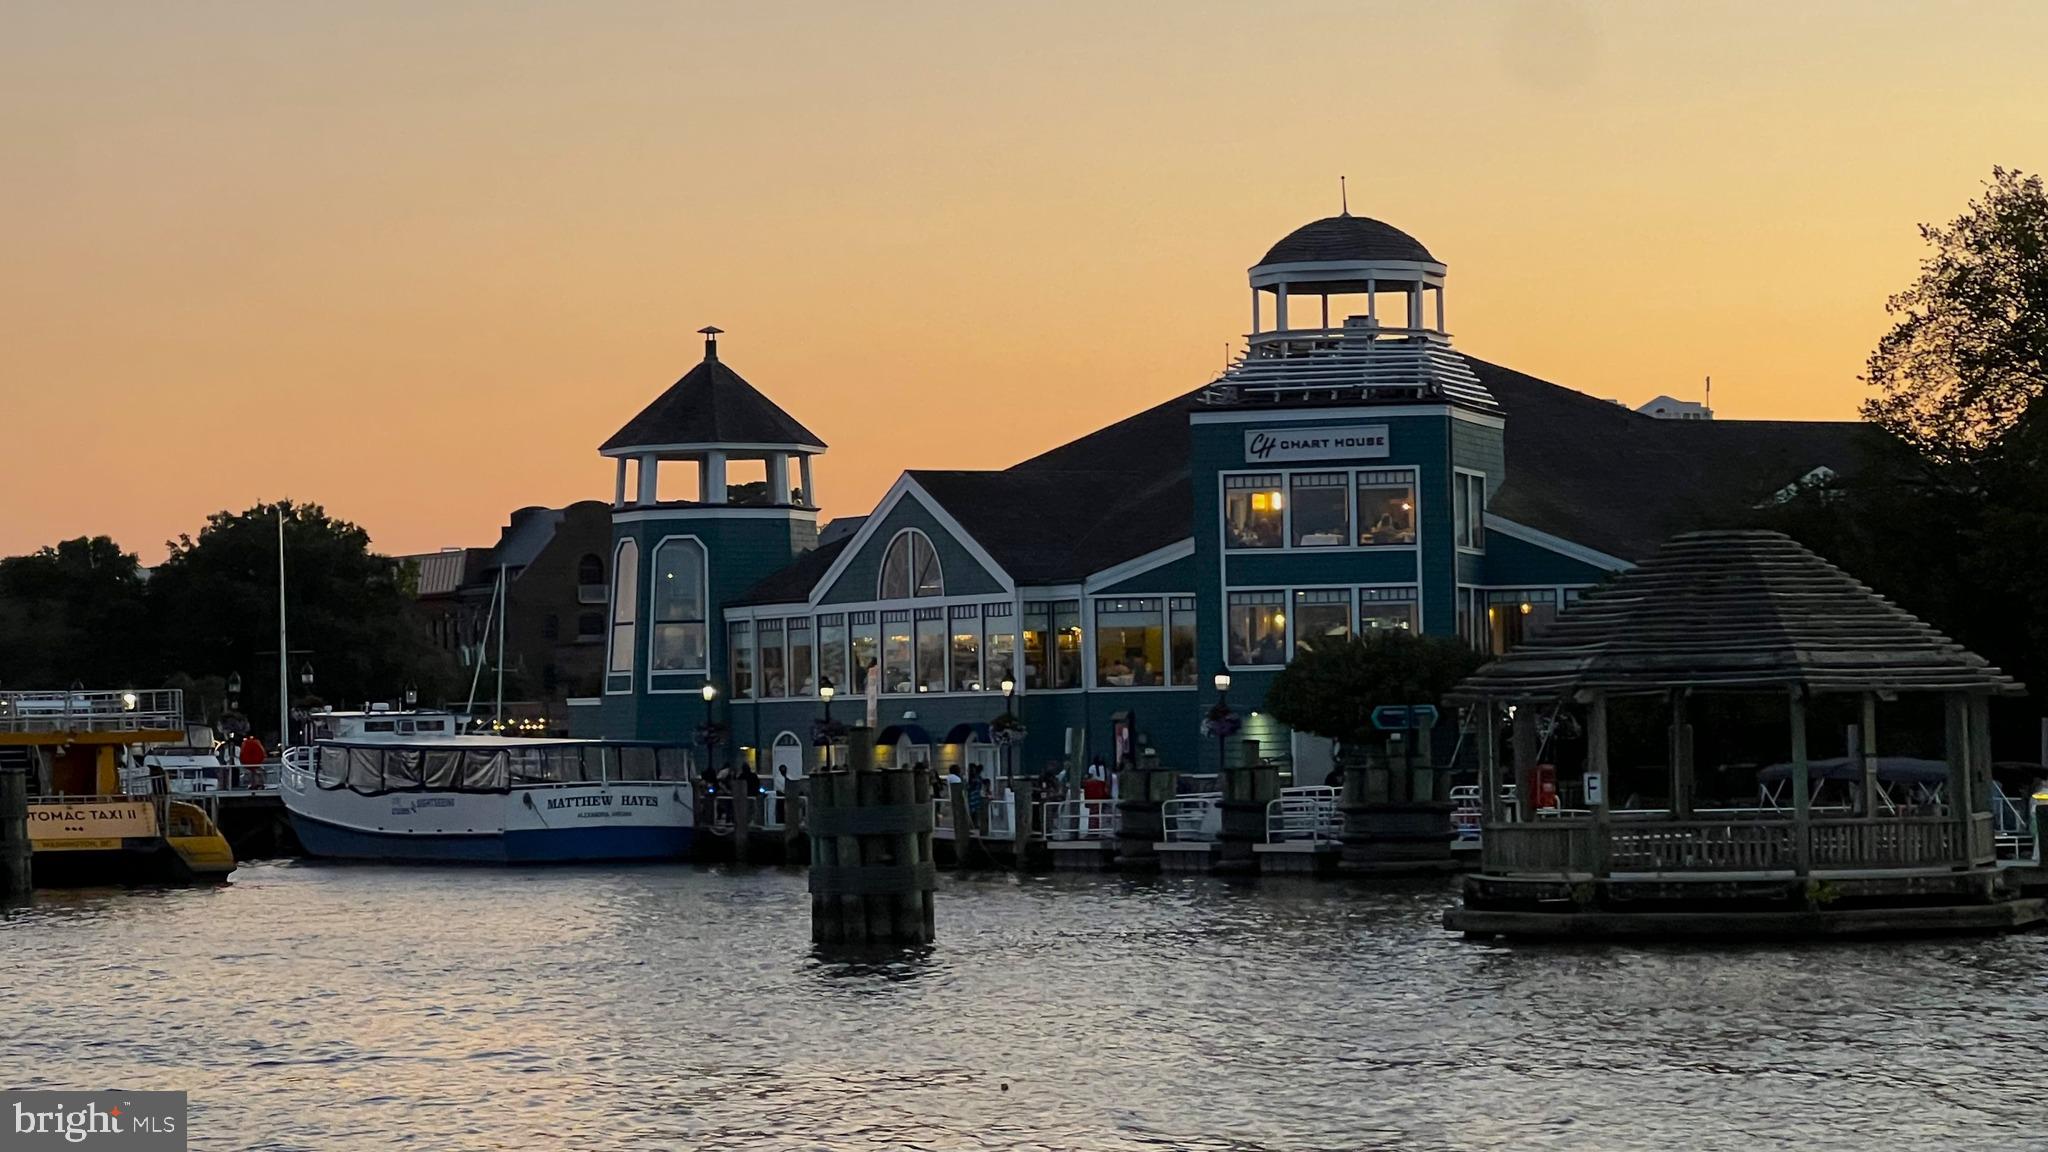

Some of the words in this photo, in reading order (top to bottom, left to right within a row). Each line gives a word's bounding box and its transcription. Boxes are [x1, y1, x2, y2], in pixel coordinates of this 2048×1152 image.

[1280, 439, 1330, 449] CHART
[1335, 436, 1385, 447] HOUSE
[1587, 776, 1598, 800] F
[547, 795, 613, 809] MATTHEW
[621, 795, 659, 807] HAYES
[26, 810, 86, 821] TOMAC
[89, 809, 123, 820] TAXI
